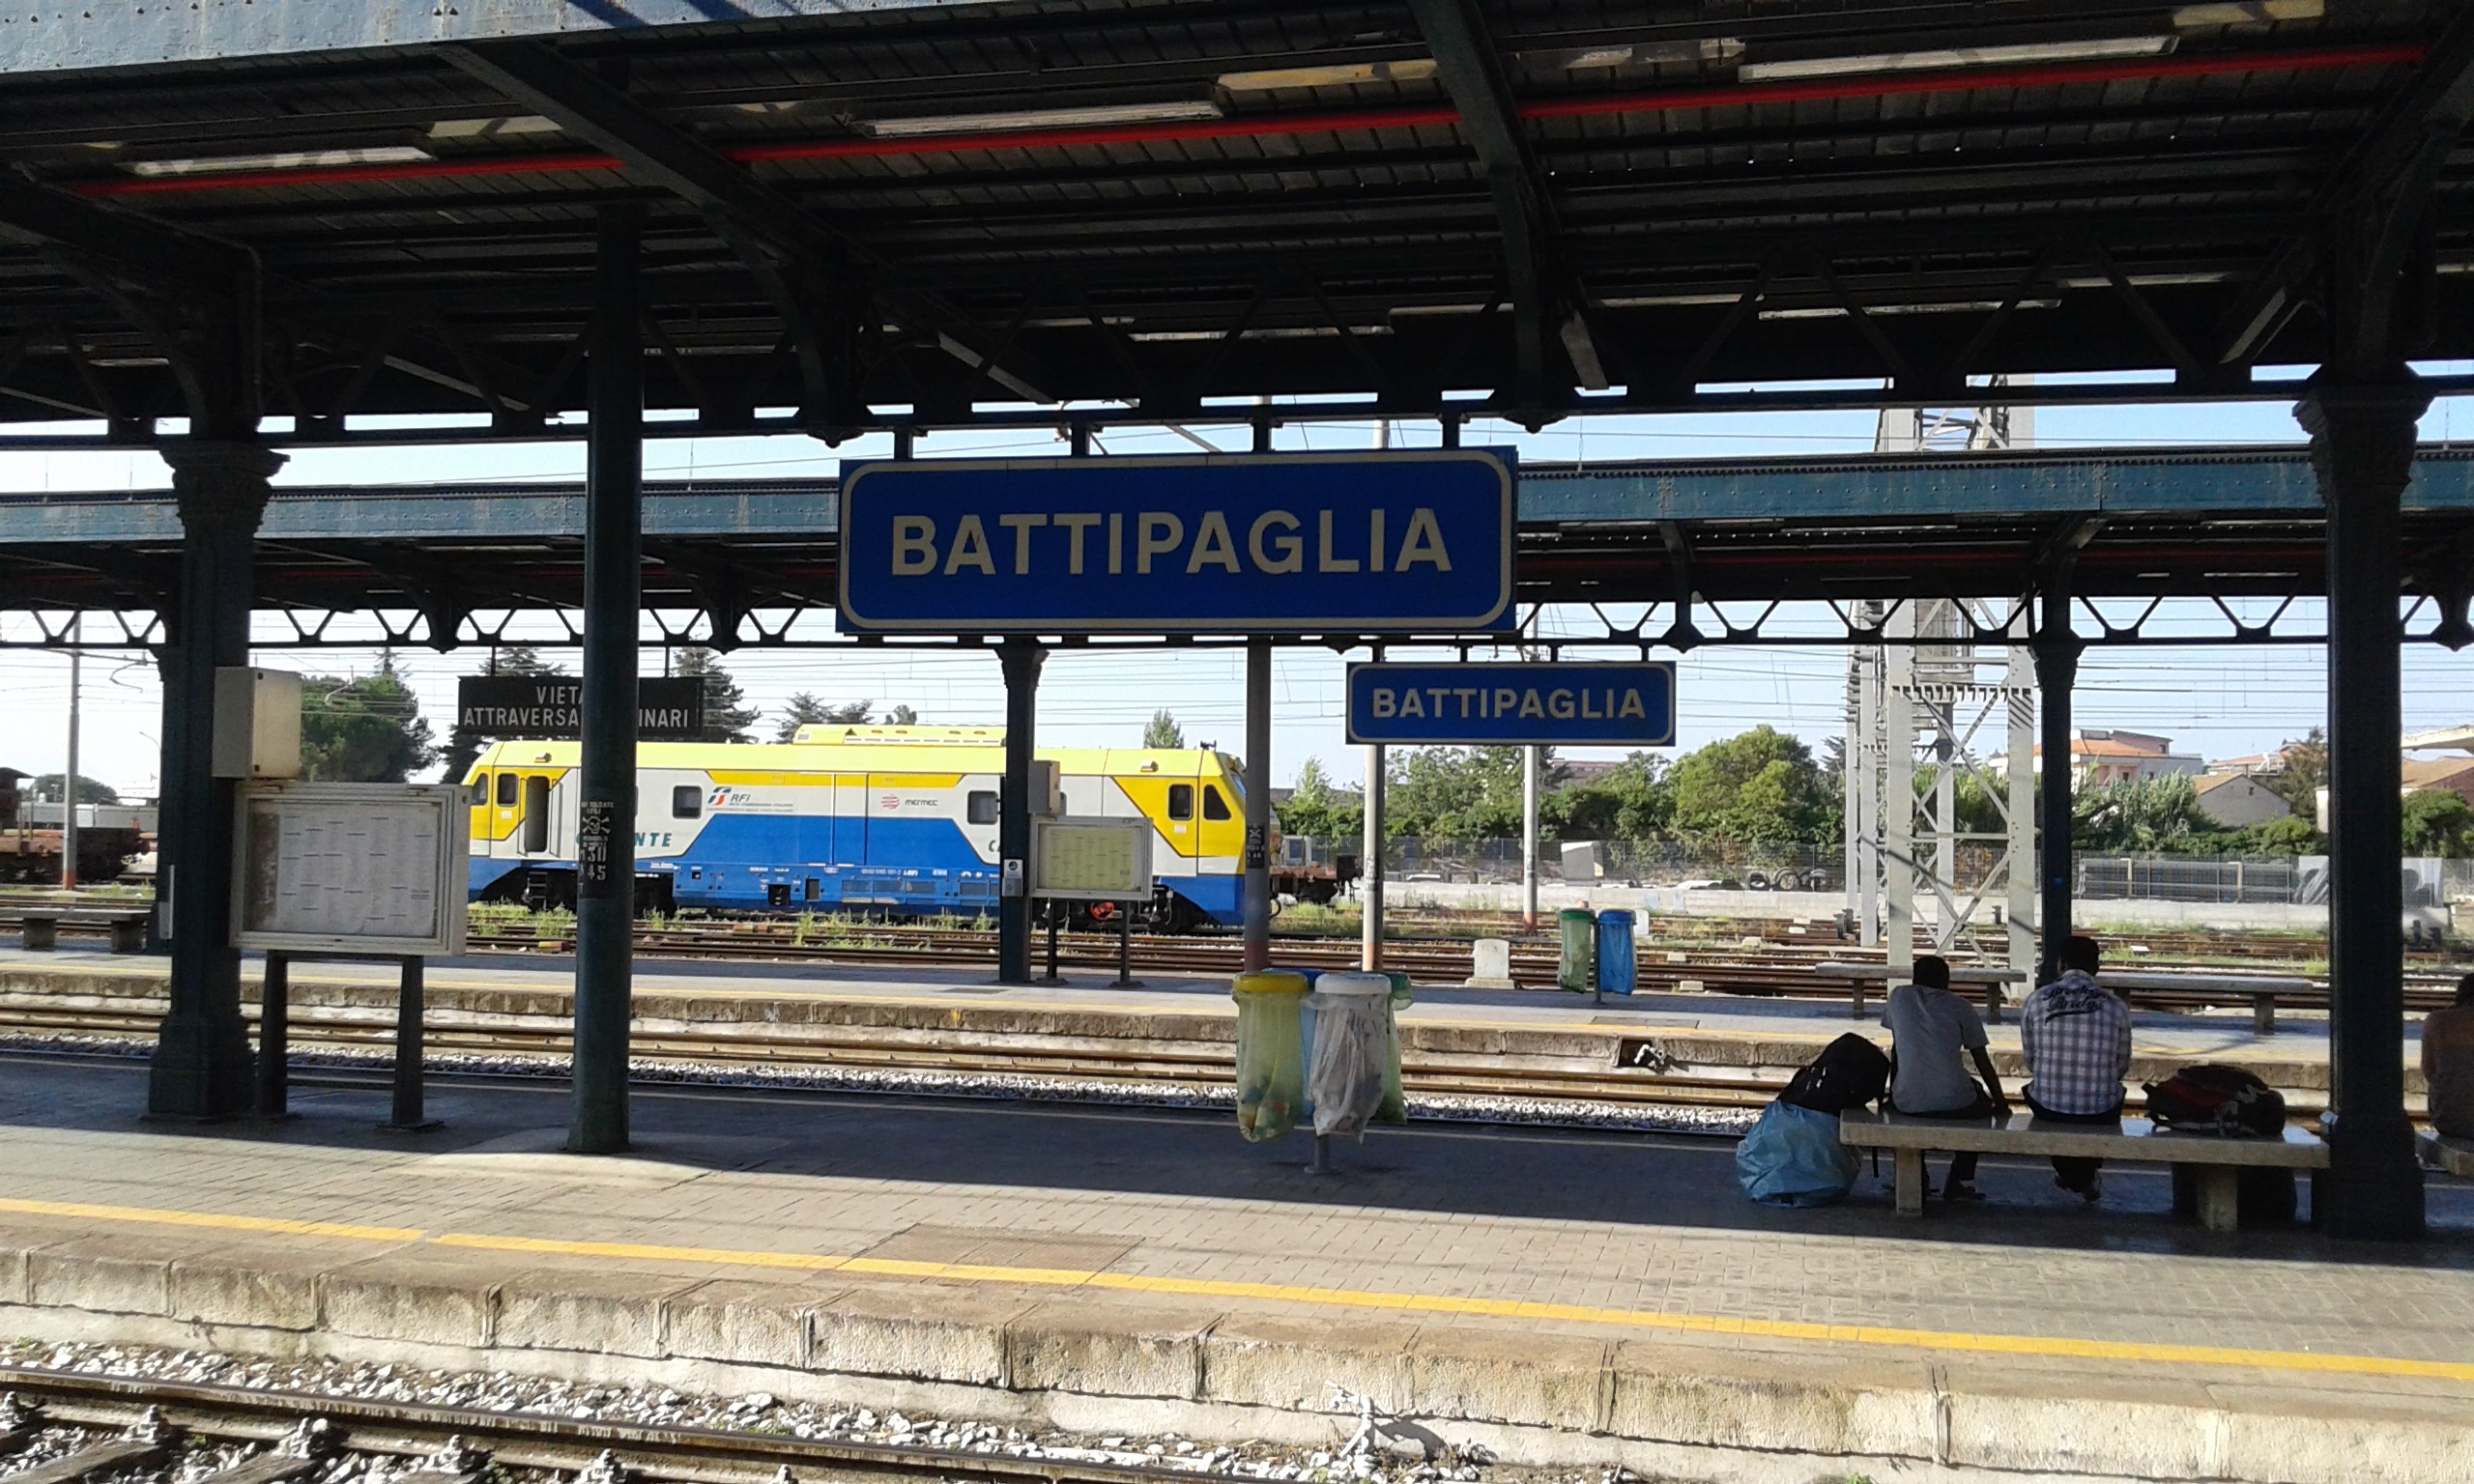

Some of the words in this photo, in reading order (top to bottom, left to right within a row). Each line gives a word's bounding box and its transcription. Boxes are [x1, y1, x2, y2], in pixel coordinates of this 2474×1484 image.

[891, 507, 1453, 576] BATTIPAGLIA
[536, 686, 583, 705] VIET
[1372, 688, 1647, 719] BATTIPAGLIA
[463, 707, 580, 727] ATTRAVERSA
[639, 708, 689, 728] INARI
[731, 793, 751, 802] RFI
